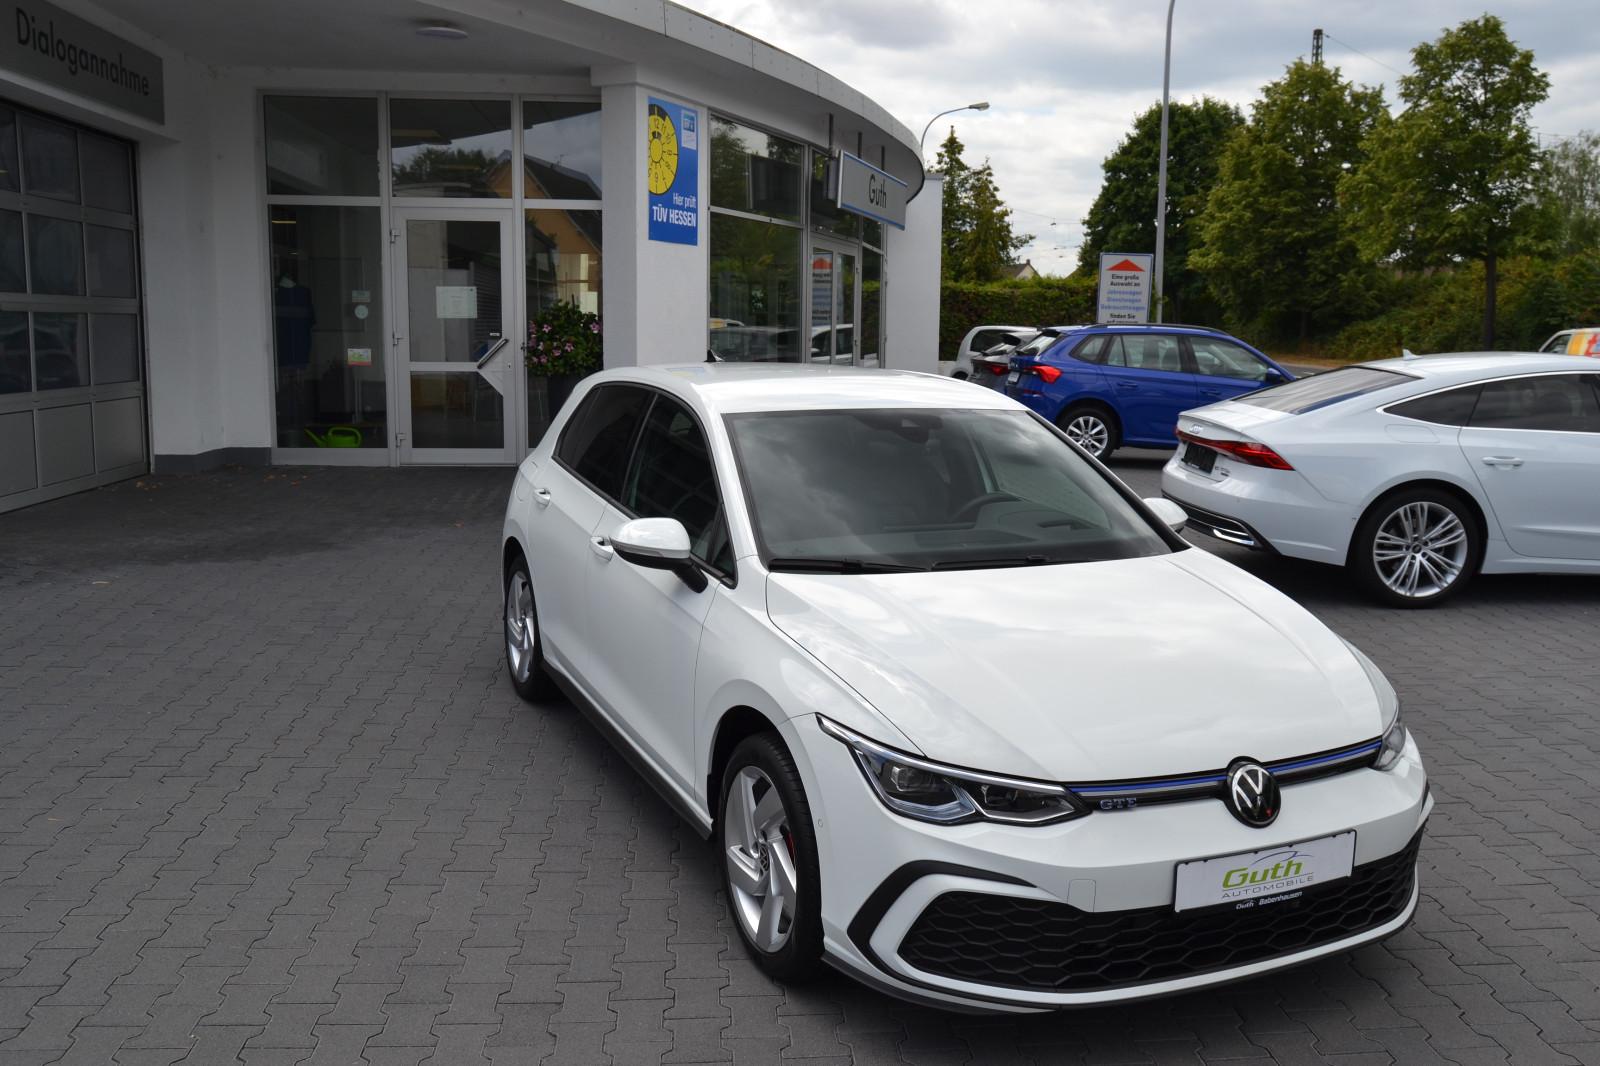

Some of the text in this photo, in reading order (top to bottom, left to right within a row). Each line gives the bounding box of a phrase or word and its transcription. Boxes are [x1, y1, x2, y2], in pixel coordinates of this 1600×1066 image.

[16, 6, 150, 96] Dialogannahme
[673, 192, 697, 209] Hier prüft
[868, 174, 887, 208] Guth
[652, 203, 697, 228] TÜV HESSEN
[1124, 273, 1139, 281] große
[1100, 797, 1137, 810] GTE
[1222, 860, 1303, 889] Guth
[1222, 875, 1314, 898] AUTOMOBILE
[1236, 891, 1303, 910] Guth Babenhausen
